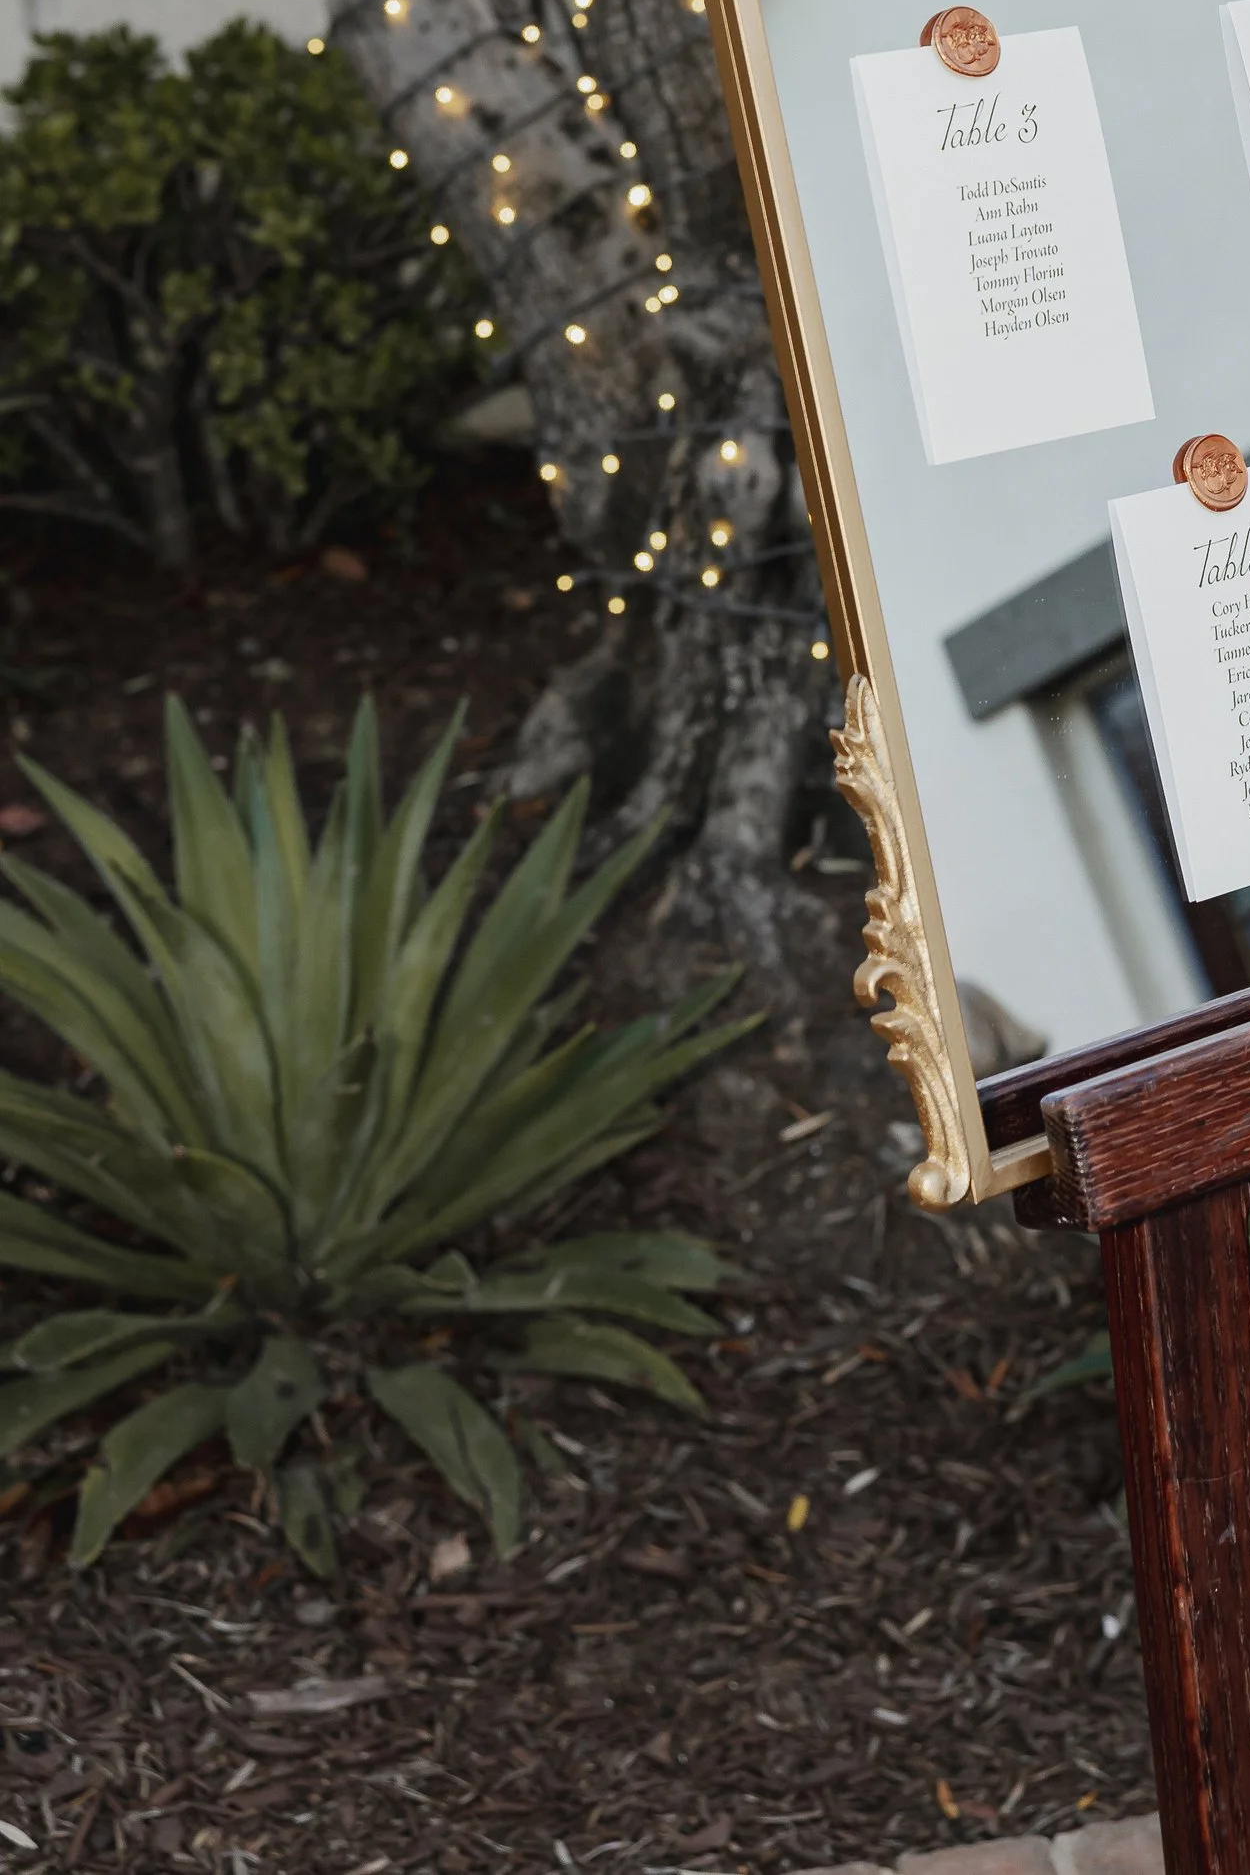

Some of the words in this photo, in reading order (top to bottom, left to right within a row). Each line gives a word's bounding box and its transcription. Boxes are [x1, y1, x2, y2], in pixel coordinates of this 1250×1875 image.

[936, 91, 1009, 151] Table
[1017, 103, 1039, 145] 3
[956, 180, 989, 201] Todd
[992, 174, 1047, 196] DeSantis
[975, 206, 1002, 222] Ann
[1005, 197, 1039, 217] Rahn
[968, 230, 1008, 247] Luana
[1011, 222, 1053, 243] Layton
[969, 247, 1009, 275] Joseph
[1010, 245, 1059, 262] Trovato
[973, 274, 1020, 292] Tommy
[1023, 262, 1064, 284] Florini
[980, 296, 1029, 315] Morgan
[1031, 286, 1066, 305] Olsen
[984, 314, 1032, 341] Hayden
[1034, 309, 1069, 328] Olsen
[1211, 601, 1241, 618] Cory
[1210, 618, 1250, 642] Tucker
